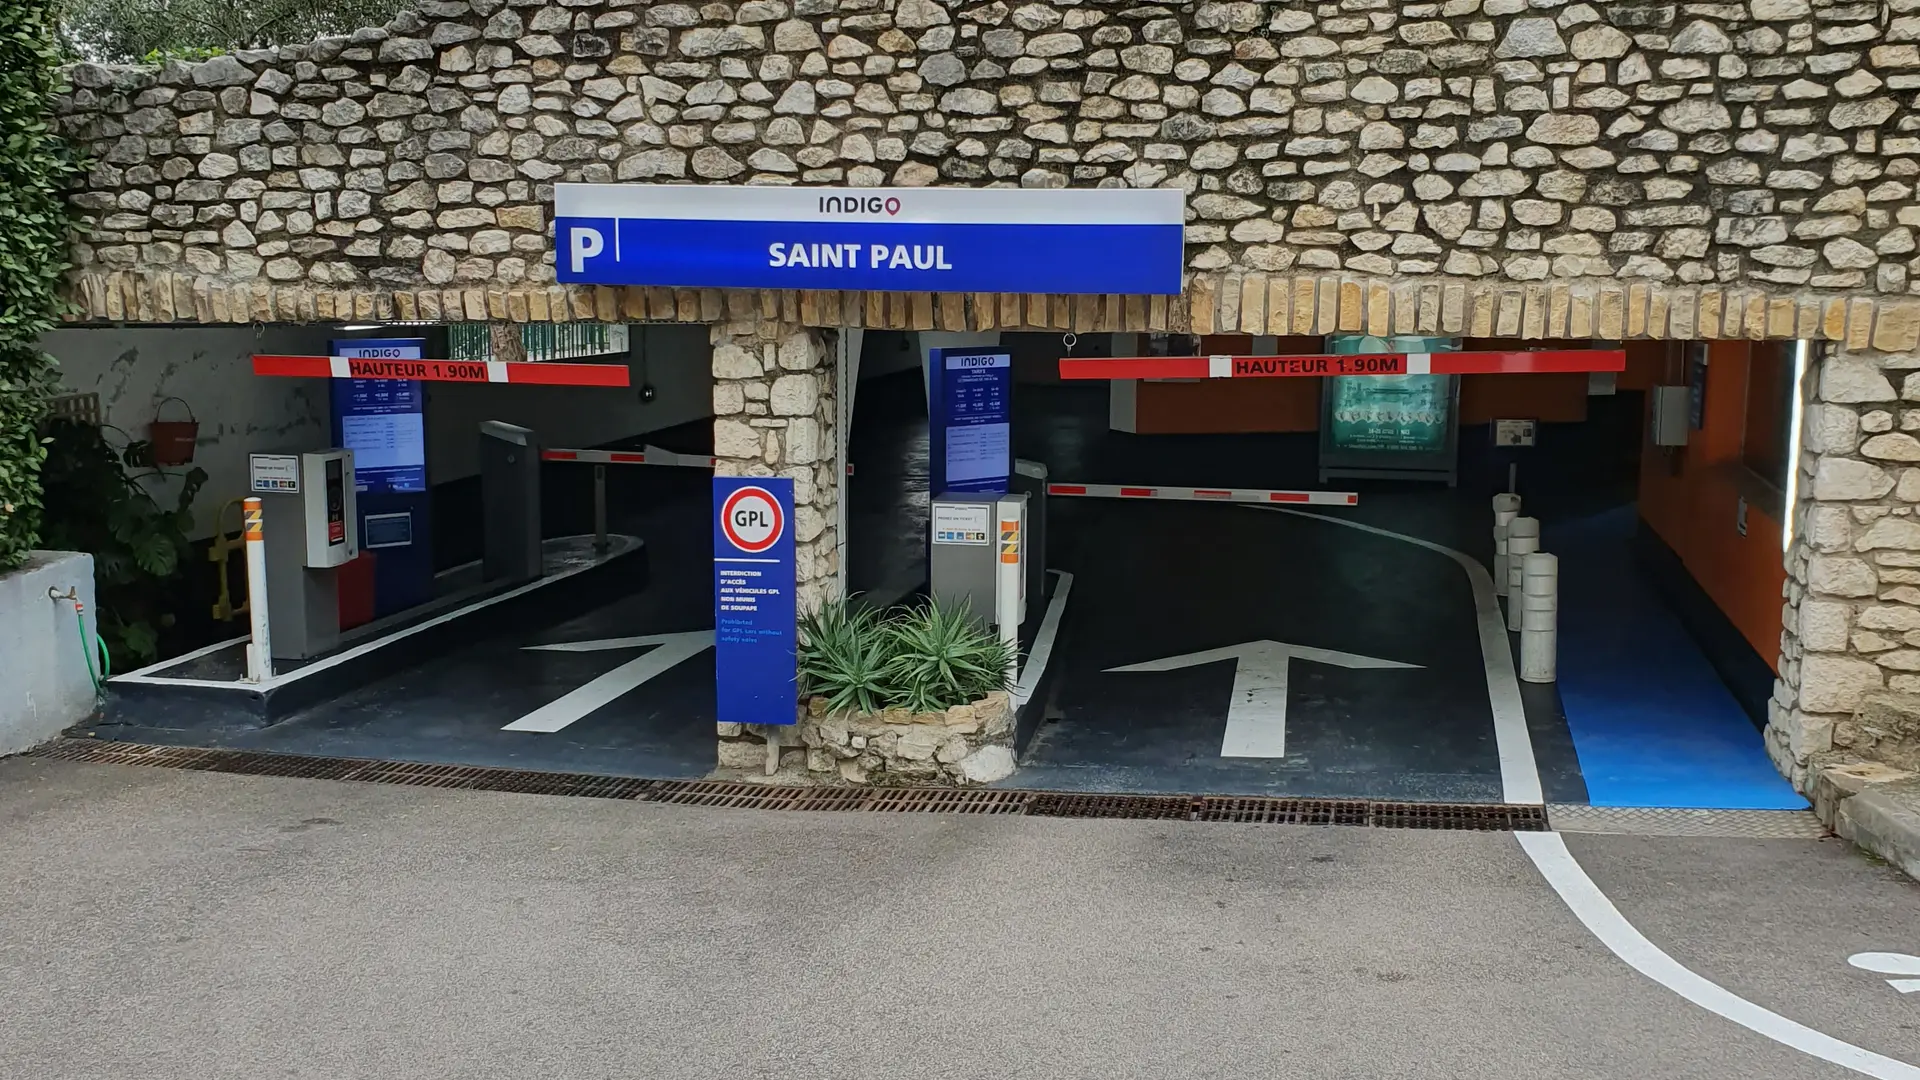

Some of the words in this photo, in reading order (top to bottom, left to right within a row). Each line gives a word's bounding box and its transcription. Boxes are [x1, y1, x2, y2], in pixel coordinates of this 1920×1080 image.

[819, 196, 901, 217] INDIGO
[570, 227, 604, 273] P
[768, 242, 861, 269] SAINT
[871, 244, 953, 270] PAUL
[359, 349, 401, 358] INDIGO
[960, 357, 995, 367] INDIGO
[349, 361, 427, 377] HAUTEUR
[433, 364, 485, 379] 1.90M
[1236, 360, 1329, 374] HAUTEUR
[1336, 358, 1399, 374] 1.90M
[735, 510, 769, 527] GPL
[735, 586, 767, 595] VÉHICULES
